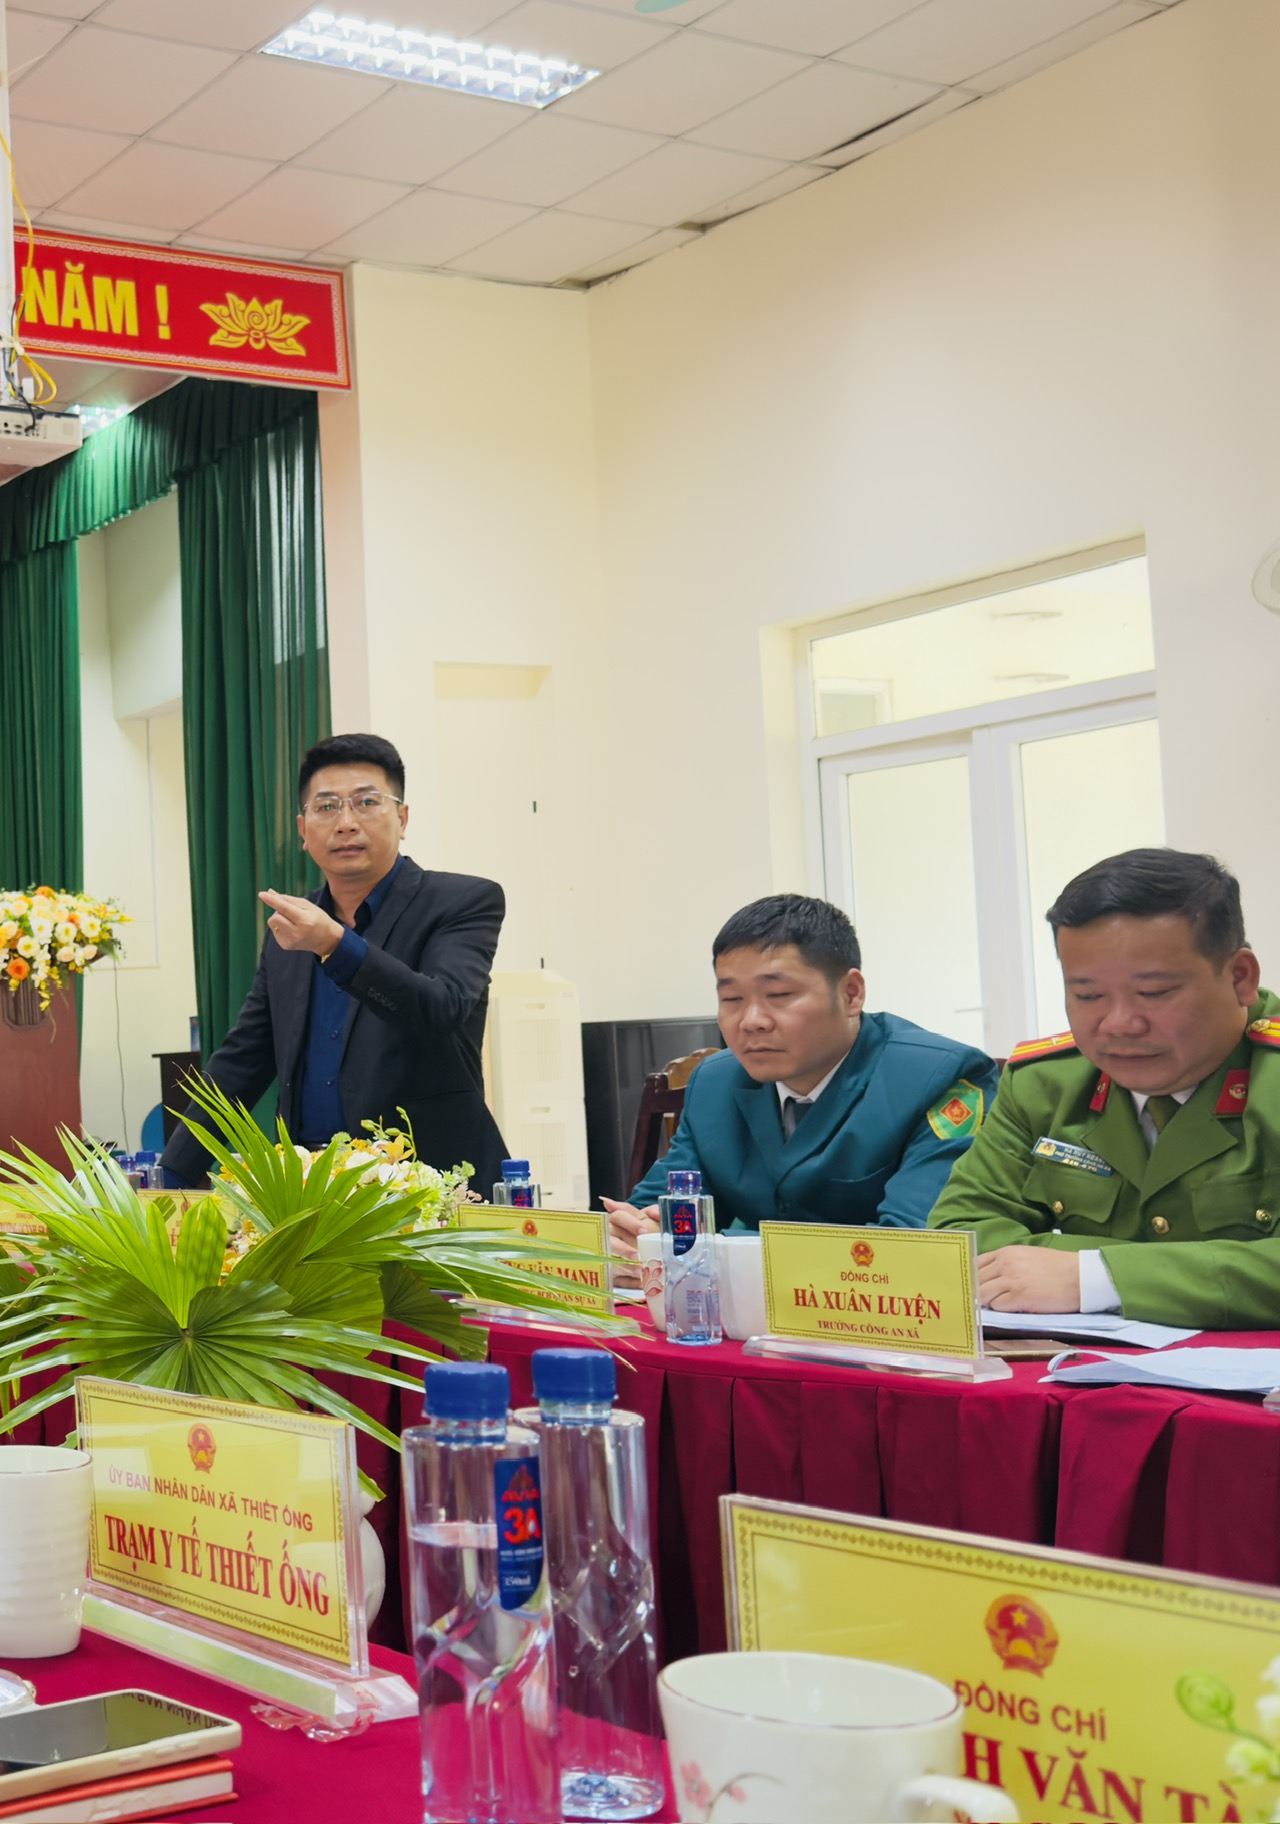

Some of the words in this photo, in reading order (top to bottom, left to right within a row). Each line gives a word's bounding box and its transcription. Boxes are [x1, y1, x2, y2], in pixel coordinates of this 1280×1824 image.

[21, 262, 139, 336] NĂM
[155, 284, 170, 340] !
[840, 1269, 869, 1283] ĐỒNG
[793, 1283, 819, 1308] HÀ
[822, 1287, 872, 1313] XUÂN
[877, 1292, 941, 1325] LUYỆN
[860, 1323, 888, 1336] CÔNG
[891, 1327, 904, 1338] AN
[907, 1327, 920, 1339] XÃ
[126, 1471, 151, 1492] BAN
[154, 1477, 188, 1500] NHÂN
[191, 1484, 216, 1509] DÂN
[219, 1491, 238, 1514] XÃ
[503, 1507, 541, 1544] 3A
[104, 1514, 157, 1572] TRẠM
[160, 1529, 173, 1569] Y
[177, 1515, 202, 1578] TẾ
[205, 1530, 274, 1599] THIẾT
[279, 1539, 330, 1616] ỐNG
[954, 1679, 1040, 1726] ĐỒNG
[1051, 1705, 1106, 1742] CHÍ
[1017, 1746, 1146, 1824] VĂN
